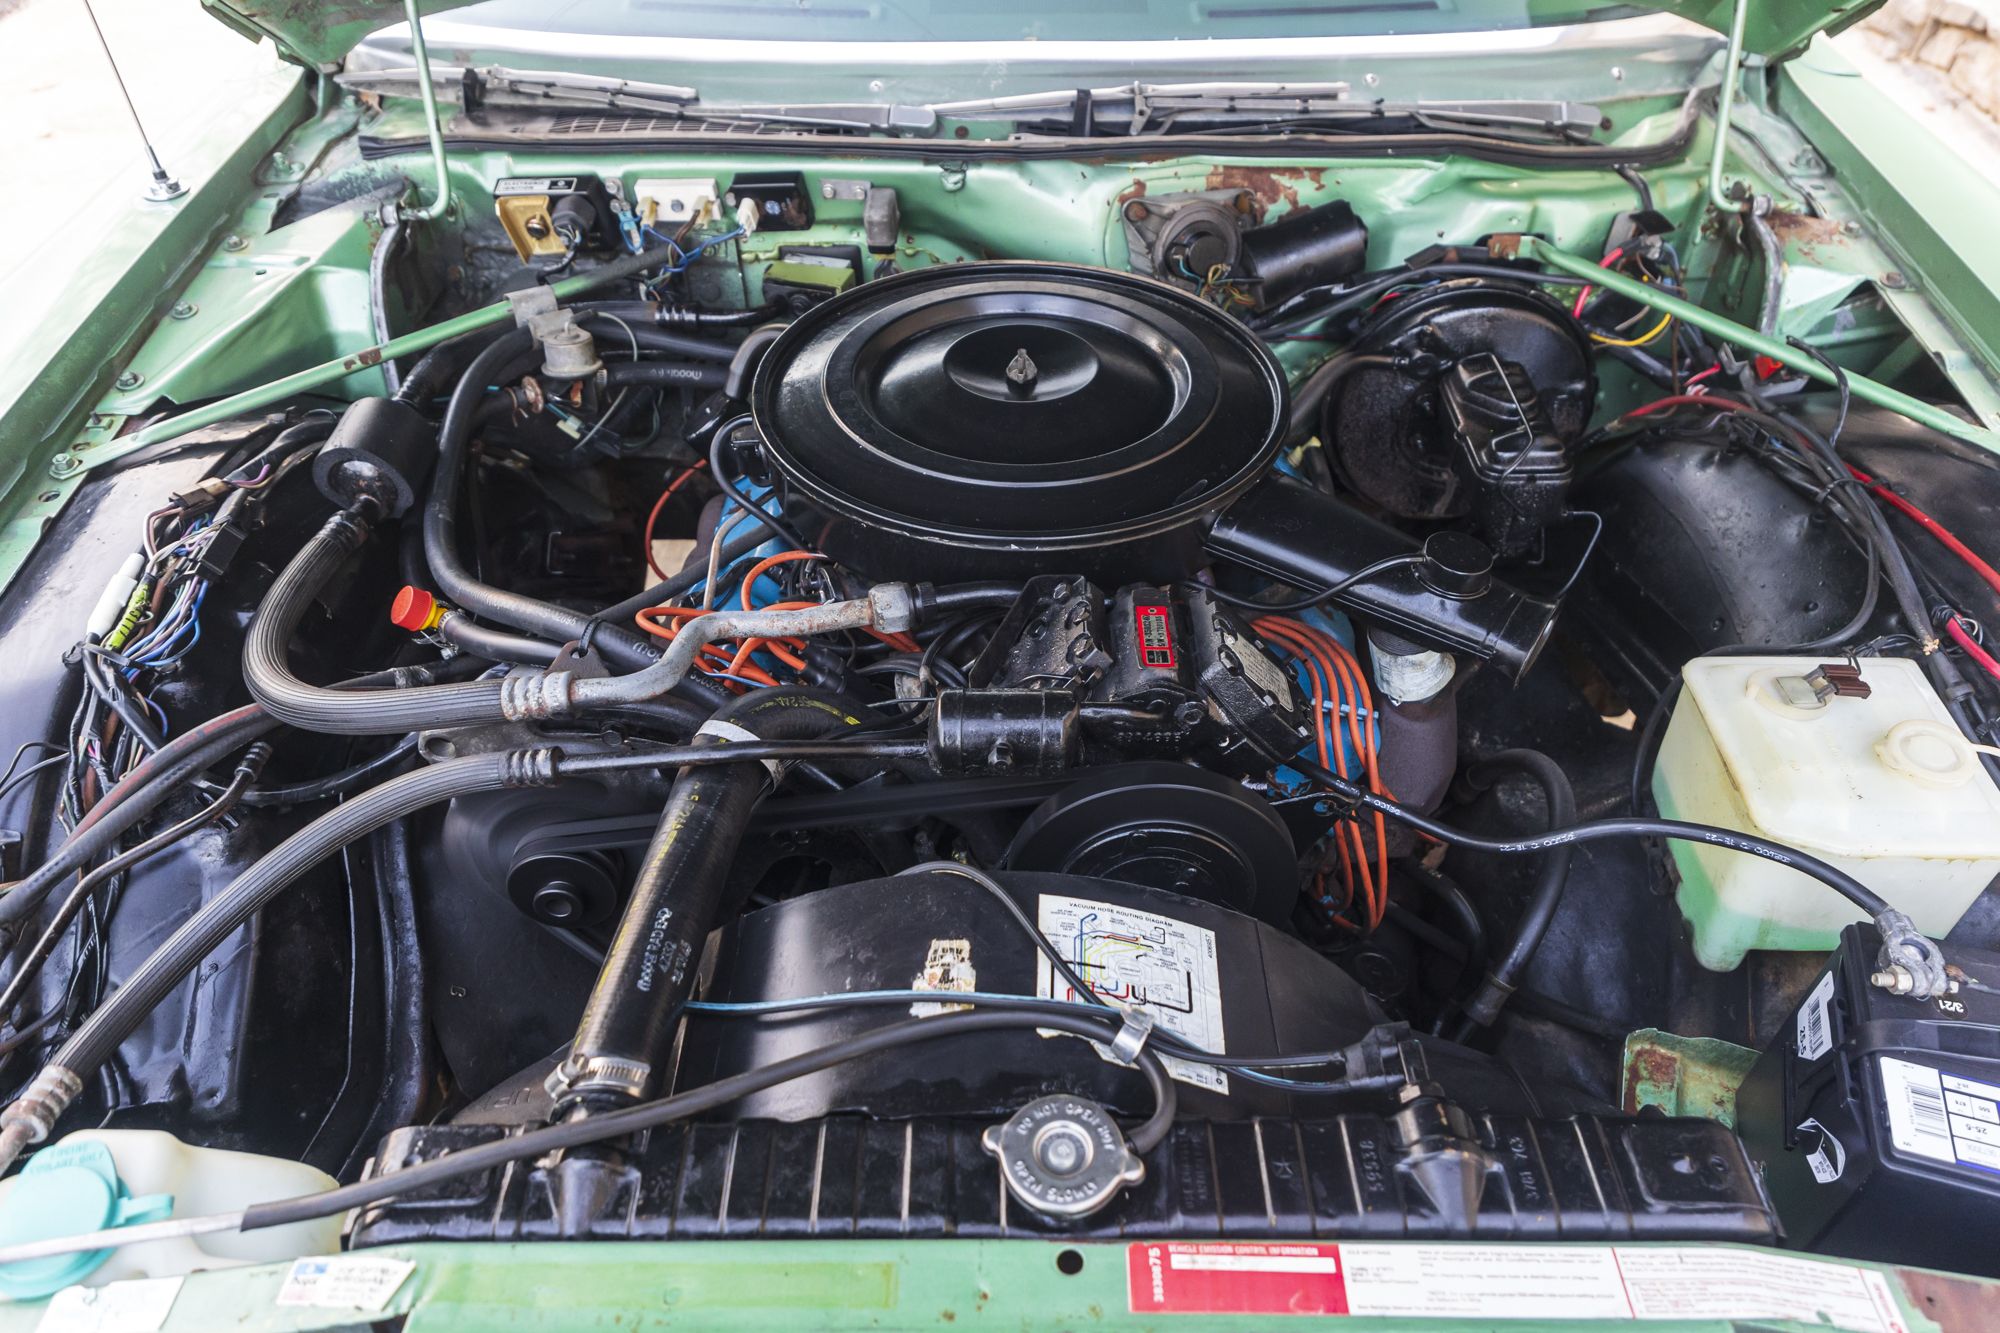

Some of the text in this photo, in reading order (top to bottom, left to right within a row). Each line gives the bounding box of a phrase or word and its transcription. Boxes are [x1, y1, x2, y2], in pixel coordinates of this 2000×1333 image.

[1069, 902, 1096, 911] VACUUM
[1097, 906, 1115, 914] HOSE
[1116, 910, 1144, 921] ROUTING
[1144, 916, 1174, 927] DIAGRAM
[1937, 998, 1966, 1014] 3/21
[1016, 1117, 1034, 1136] DO
[1034, 1103, 1060, 1119] NOT
[1064, 1103, 1101, 1126] OPEN
[1964, 1123, 1988, 1135] 25-5
[1013, 1160, 1098, 1203] OPEN SLOWLY
[1167, 1244, 1319, 1256] VEHICLE EMISSION CONTROL INFORMATION
